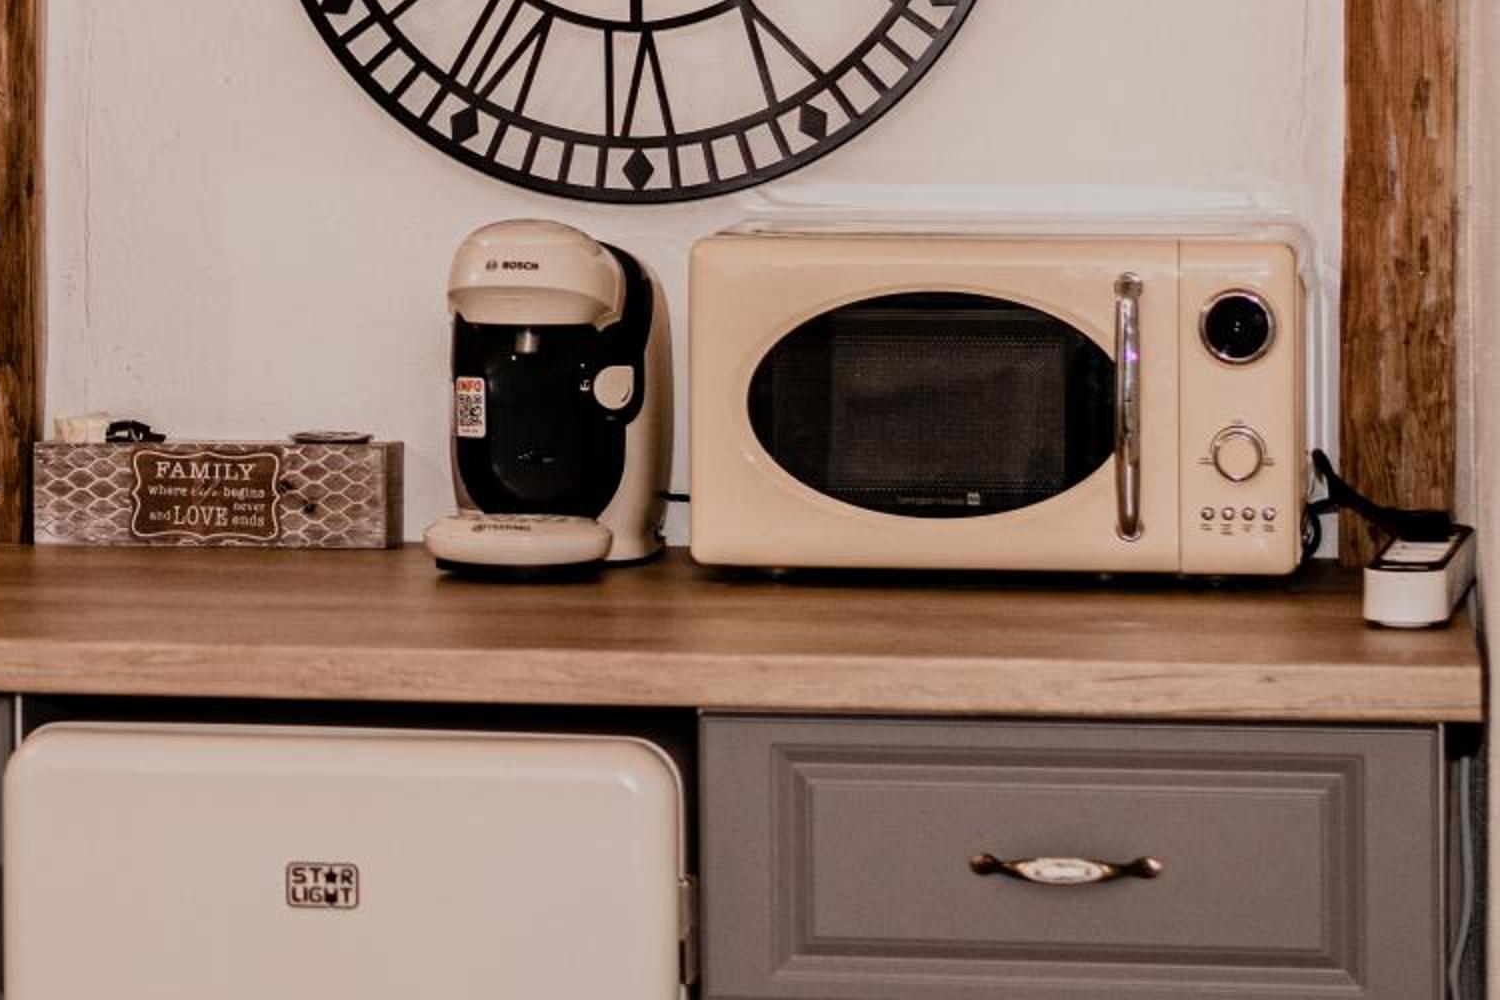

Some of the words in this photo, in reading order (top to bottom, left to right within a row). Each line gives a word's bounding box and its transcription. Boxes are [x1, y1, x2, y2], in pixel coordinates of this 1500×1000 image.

[502, 260, 539, 271] BOSCH
[457, 379, 483, 392] INFO
[156, 461, 257, 481] FAMILY
[148, 485, 188, 496] where
[223, 486, 266, 500] begins
[149, 510, 171, 521] and
[173, 505, 228, 527] LOVE
[232, 503, 266, 512] never
[231, 514, 265, 527] ends
